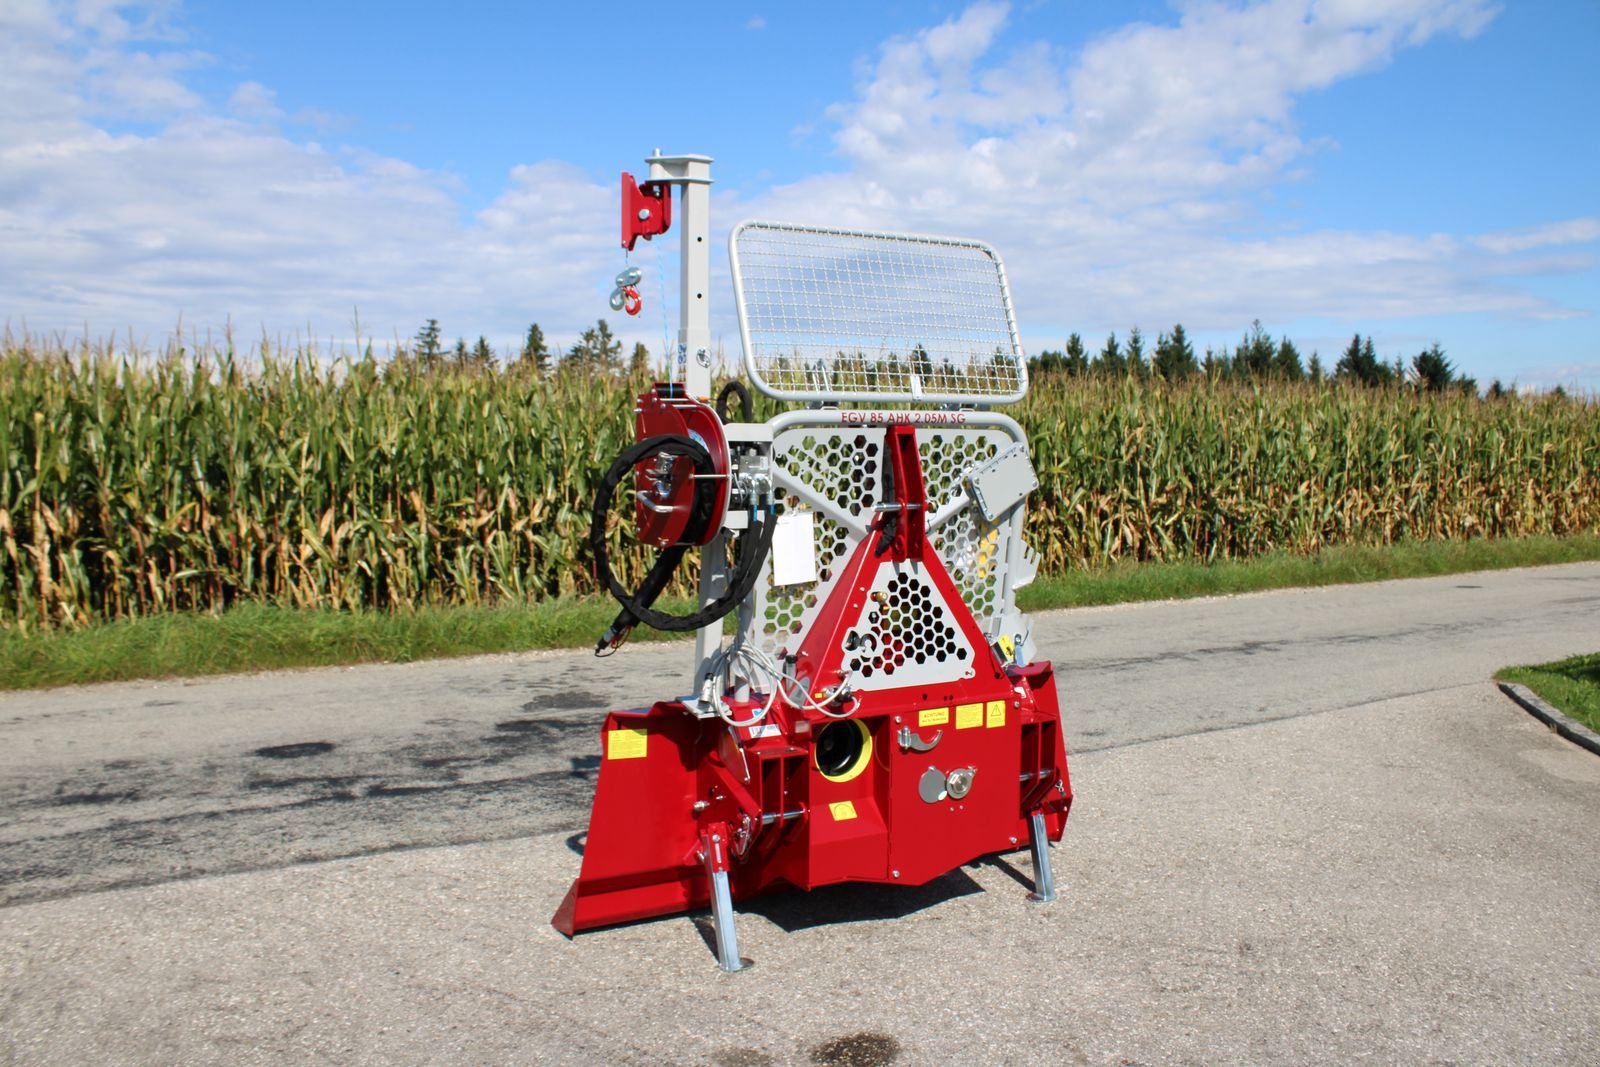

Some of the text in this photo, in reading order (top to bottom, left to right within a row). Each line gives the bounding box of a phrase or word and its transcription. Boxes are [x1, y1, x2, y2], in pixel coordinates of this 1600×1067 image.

[841, 412, 966, 424] EGV 85 AHK 2.05M SG
